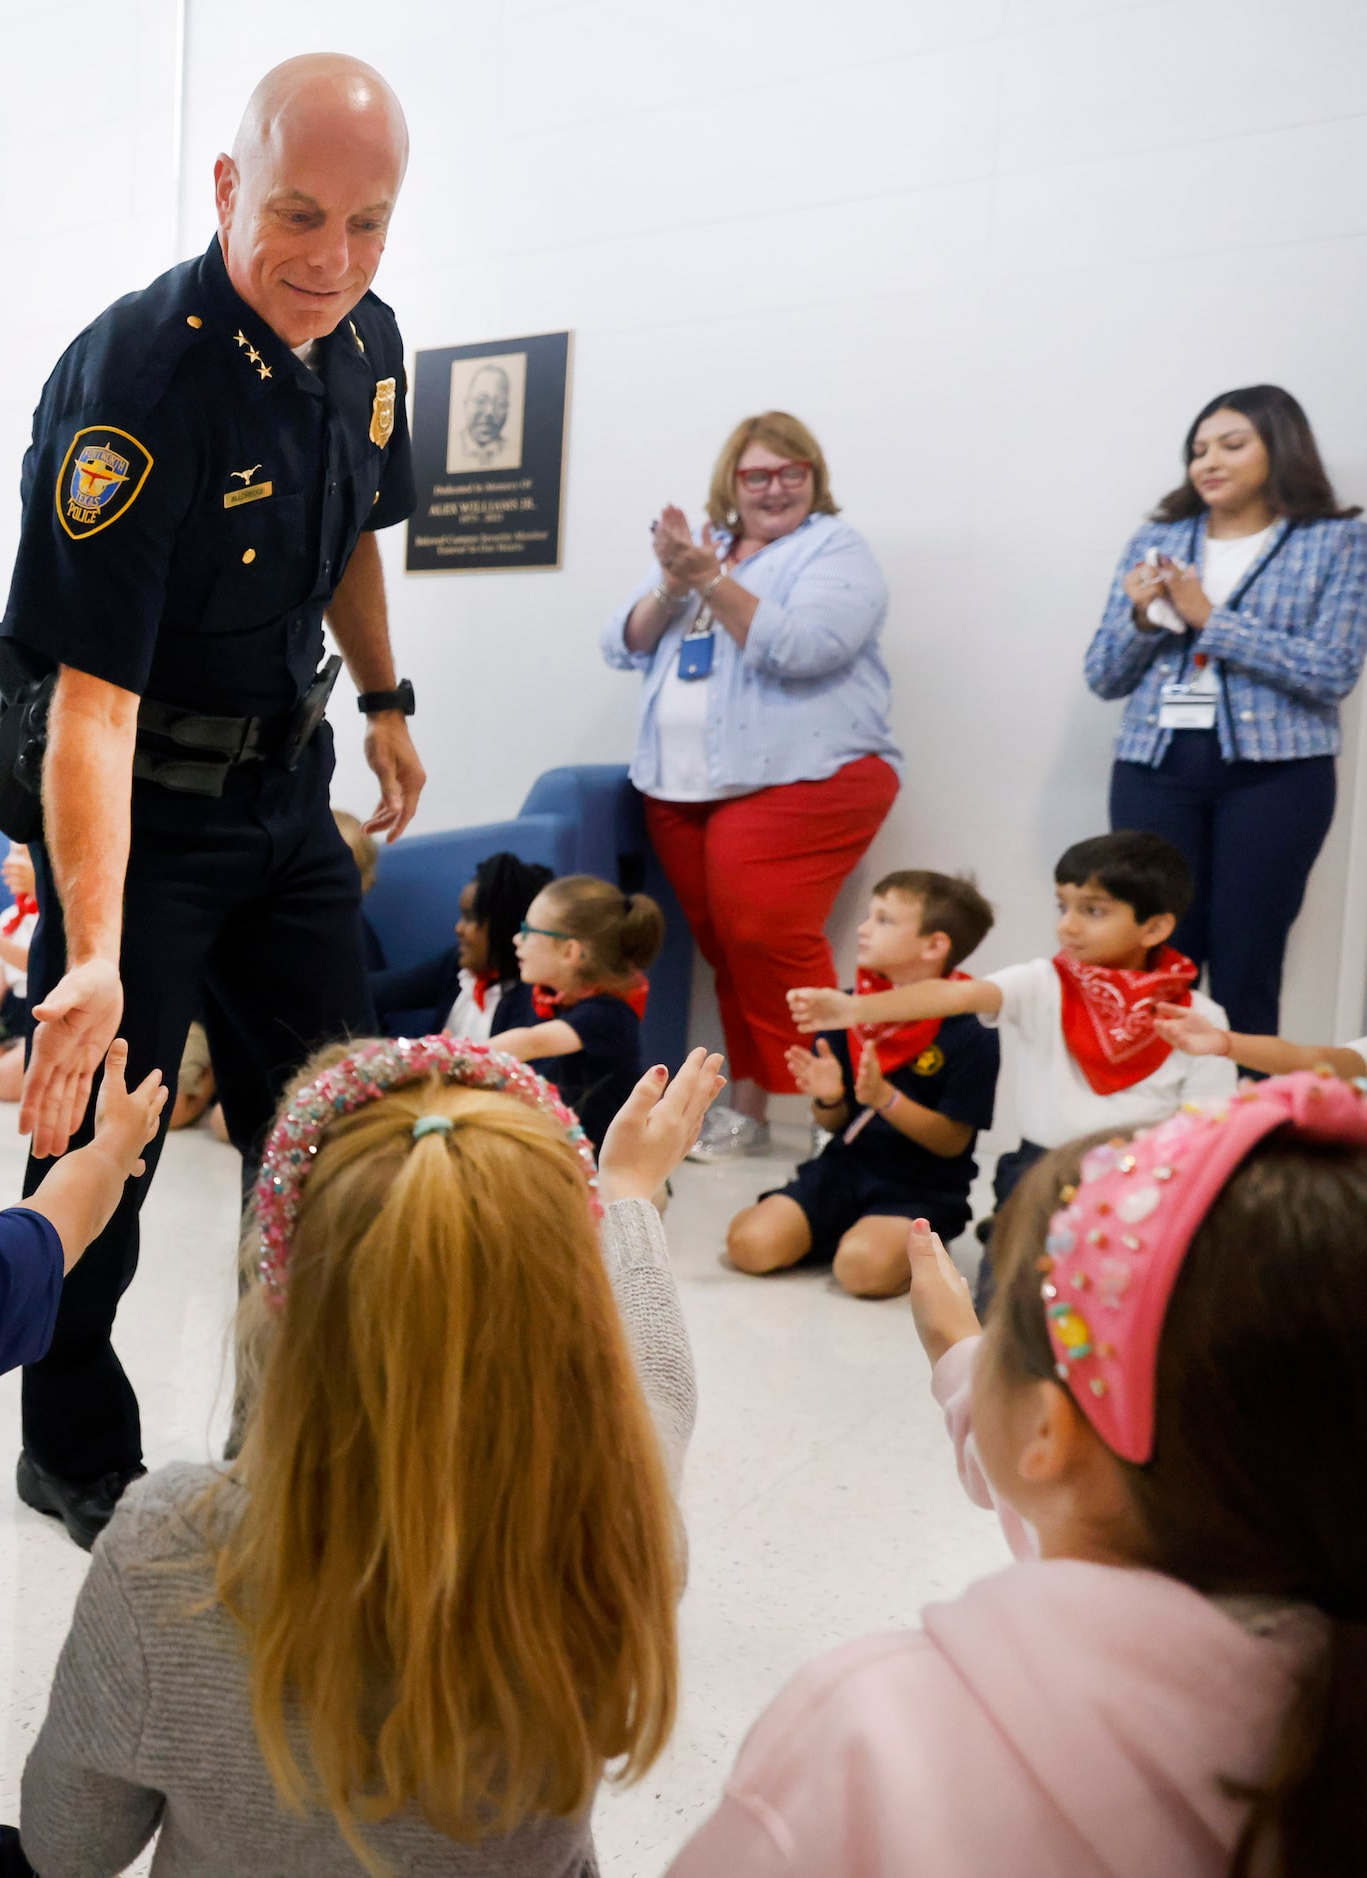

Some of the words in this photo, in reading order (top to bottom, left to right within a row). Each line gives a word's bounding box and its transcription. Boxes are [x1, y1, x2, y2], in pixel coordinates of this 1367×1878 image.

[75, 490, 101, 507] TEXAS
[67, 501, 98, 524] POLICE
[428, 503, 458, 516] ALEX
[458, 499, 518, 514] WILLIAMS
